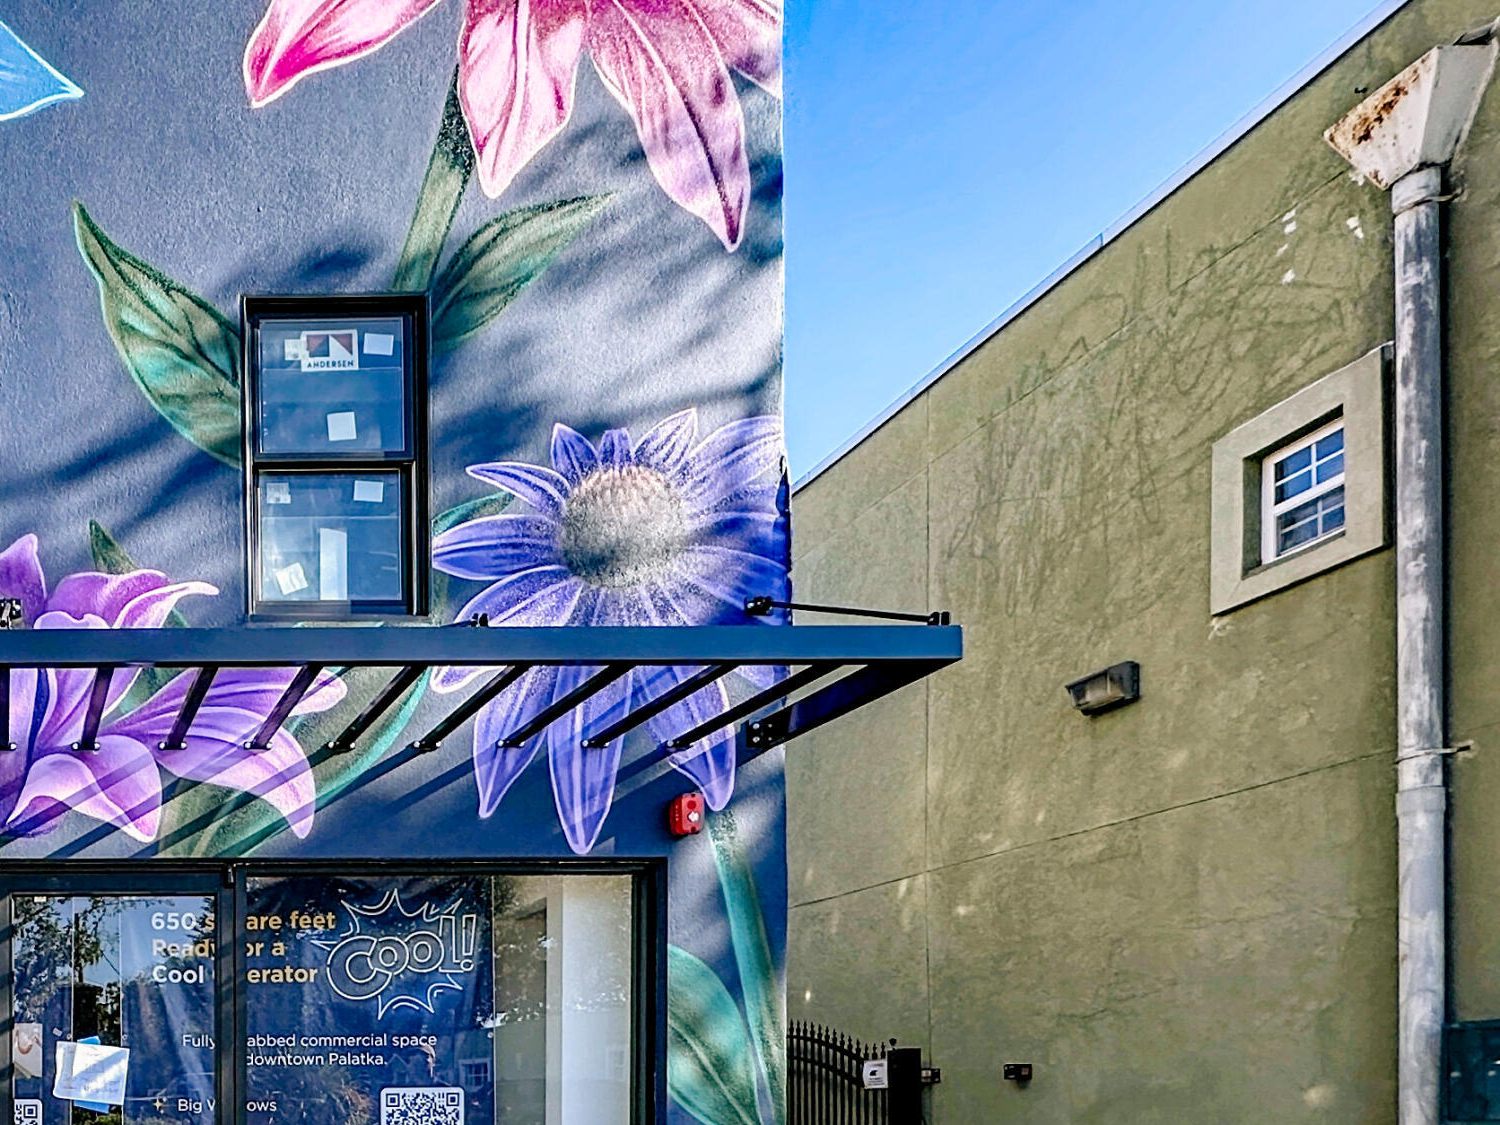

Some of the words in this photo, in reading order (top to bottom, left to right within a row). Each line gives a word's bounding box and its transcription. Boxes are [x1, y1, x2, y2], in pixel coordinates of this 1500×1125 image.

[307, 360, 354, 368] ANDERSEN
[152, 912, 196, 931] 650
[204, 915, 282, 931] sare
[290, 909, 336, 930] feet
[271, 940, 285, 957] a
[153, 965, 204, 984] Cool
[300, 1033, 388, 1047] commercial
[392, 1035, 438, 1050] space
[329, 1052, 388, 1066] Palatka.
[178, 1098, 203, 1113] Big
